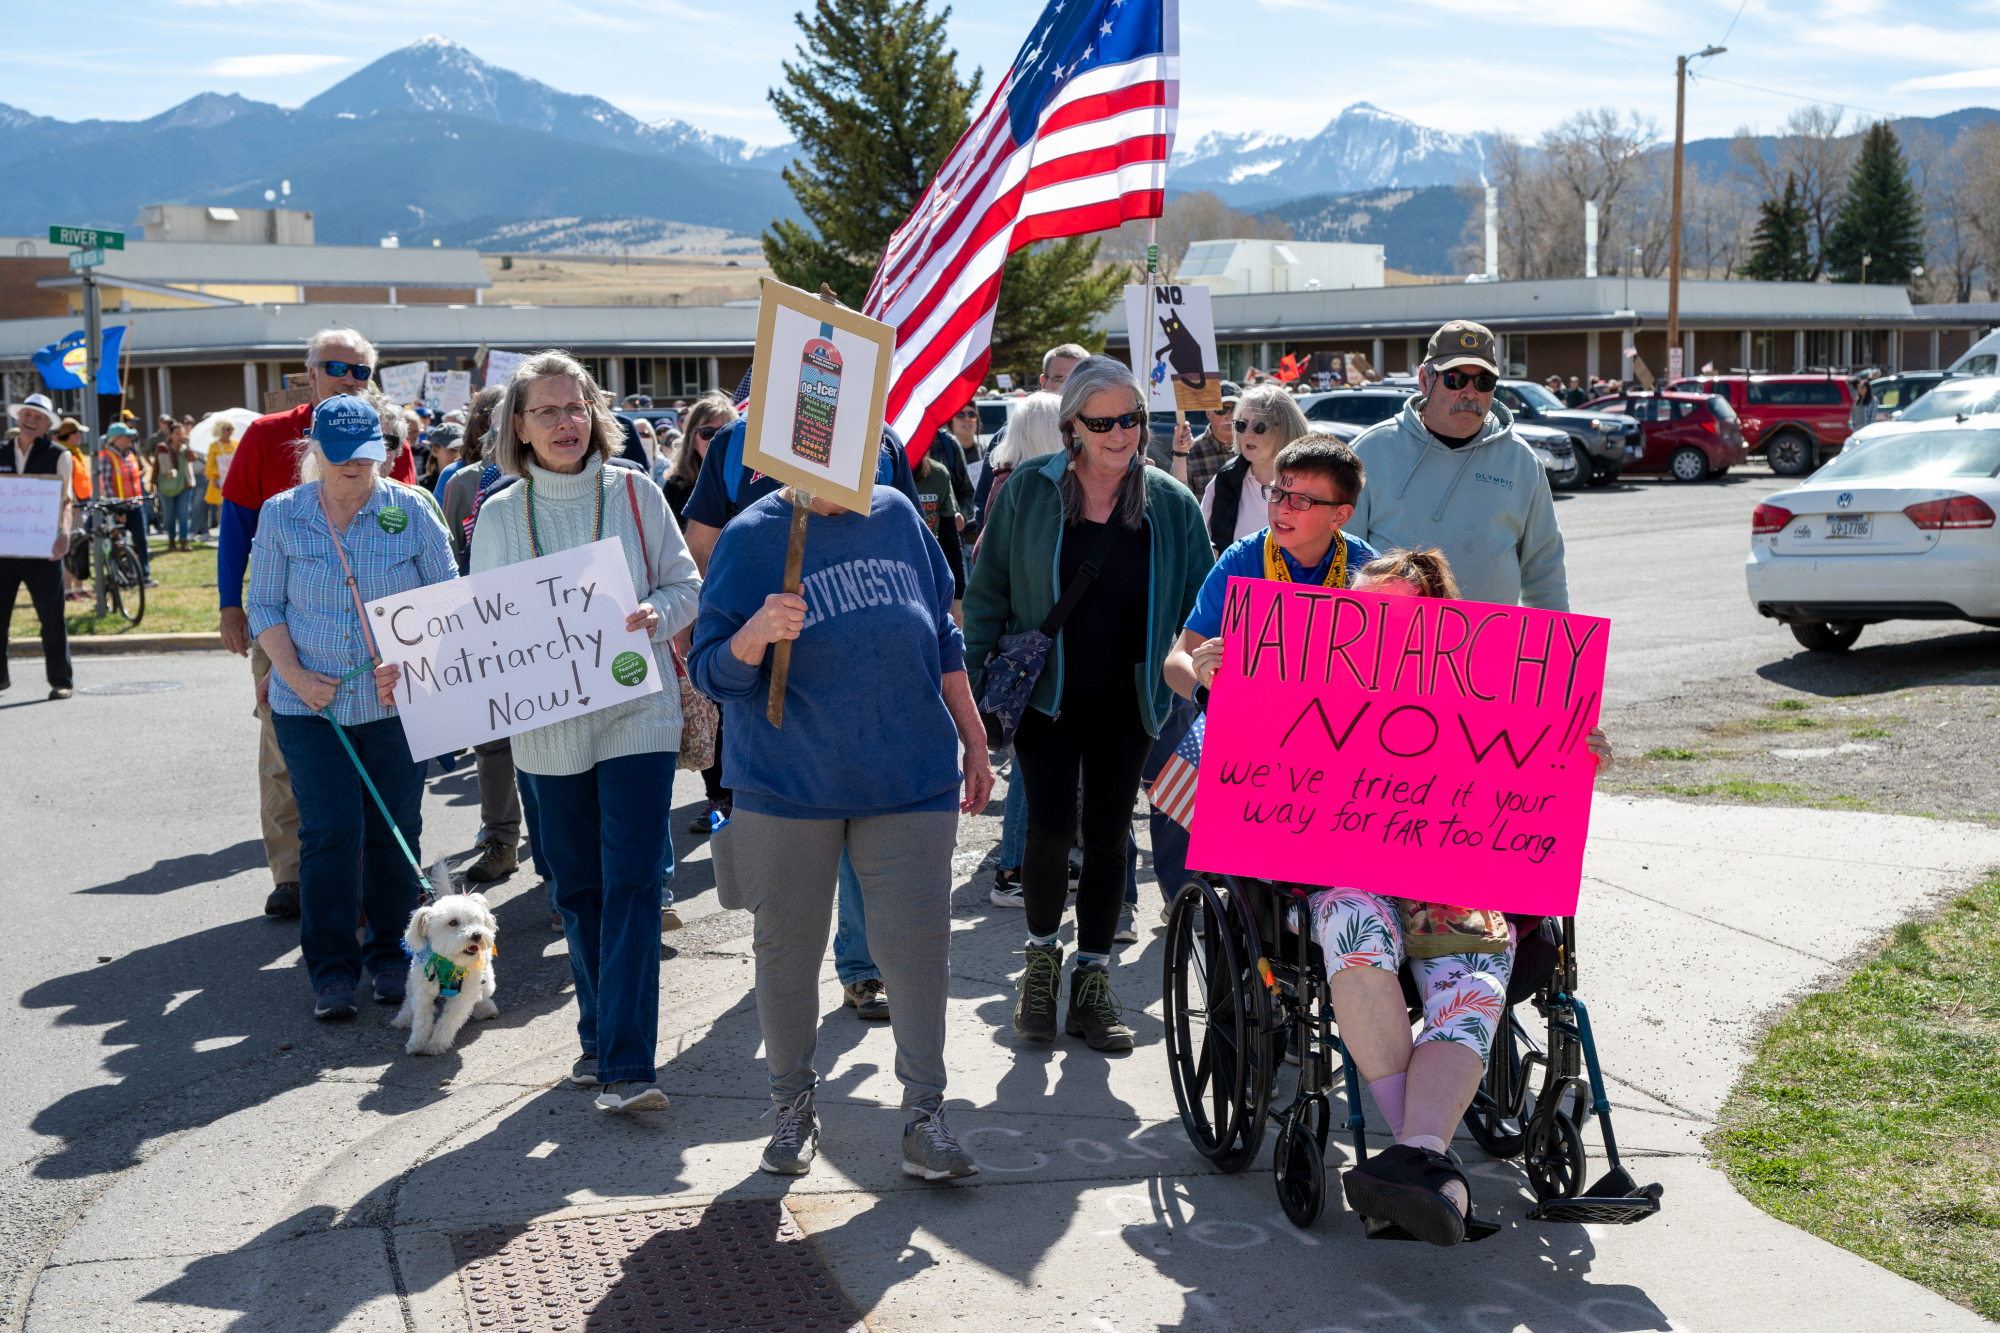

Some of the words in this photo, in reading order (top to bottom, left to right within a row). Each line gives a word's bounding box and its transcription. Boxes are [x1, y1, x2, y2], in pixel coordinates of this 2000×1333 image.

[60, 228, 97, 246] RIVER
[104, 235, 114, 244] DR
[1155, 285, 1186, 306] NO.
[801, 381, 838, 398] De-Icer
[266, 391, 279, 409] IF
[820, 403, 831, 411] ICE
[802, 410, 829, 424] Instantly
[806, 404, 827, 416] Agents
[798, 415, 815, 426] Stops
[815, 421, 832, 433] Them
[810, 427, 827, 437] Their
[796, 445, 828, 462] CRUELTY
[801, 439, 824, 452] STOPS
[1281, 475, 1293, 487] NO
[1475, 472, 1513, 488] OLYMPIC
[12, 483, 57, 499] Bathroom
[382, 519, 403, 529] Protester
[384, 514, 403, 523] Peaceful
[390, 604, 464, 646] Can
[472, 592, 520, 625] We
[535, 575, 597, 613] Try
[1215, 583, 1601, 712] MATRIARCHY
[402, 616, 603, 704] Matriarchy
[614, 653, 635, 665] UNPAID
[618, 660, 640, 674] Peaceful
[620, 667, 644, 681] Protester
[488, 659, 592, 731] Now!
[1279, 691, 1597, 771] NOW!!
[1352, 767, 1438, 807] tried
[1452, 781, 1475, 808] it
[1489, 790, 1557, 829] your
[1243, 800, 1316, 835] way
[1329, 801, 1378, 833] for
[1492, 819, 1556, 864] Long.
